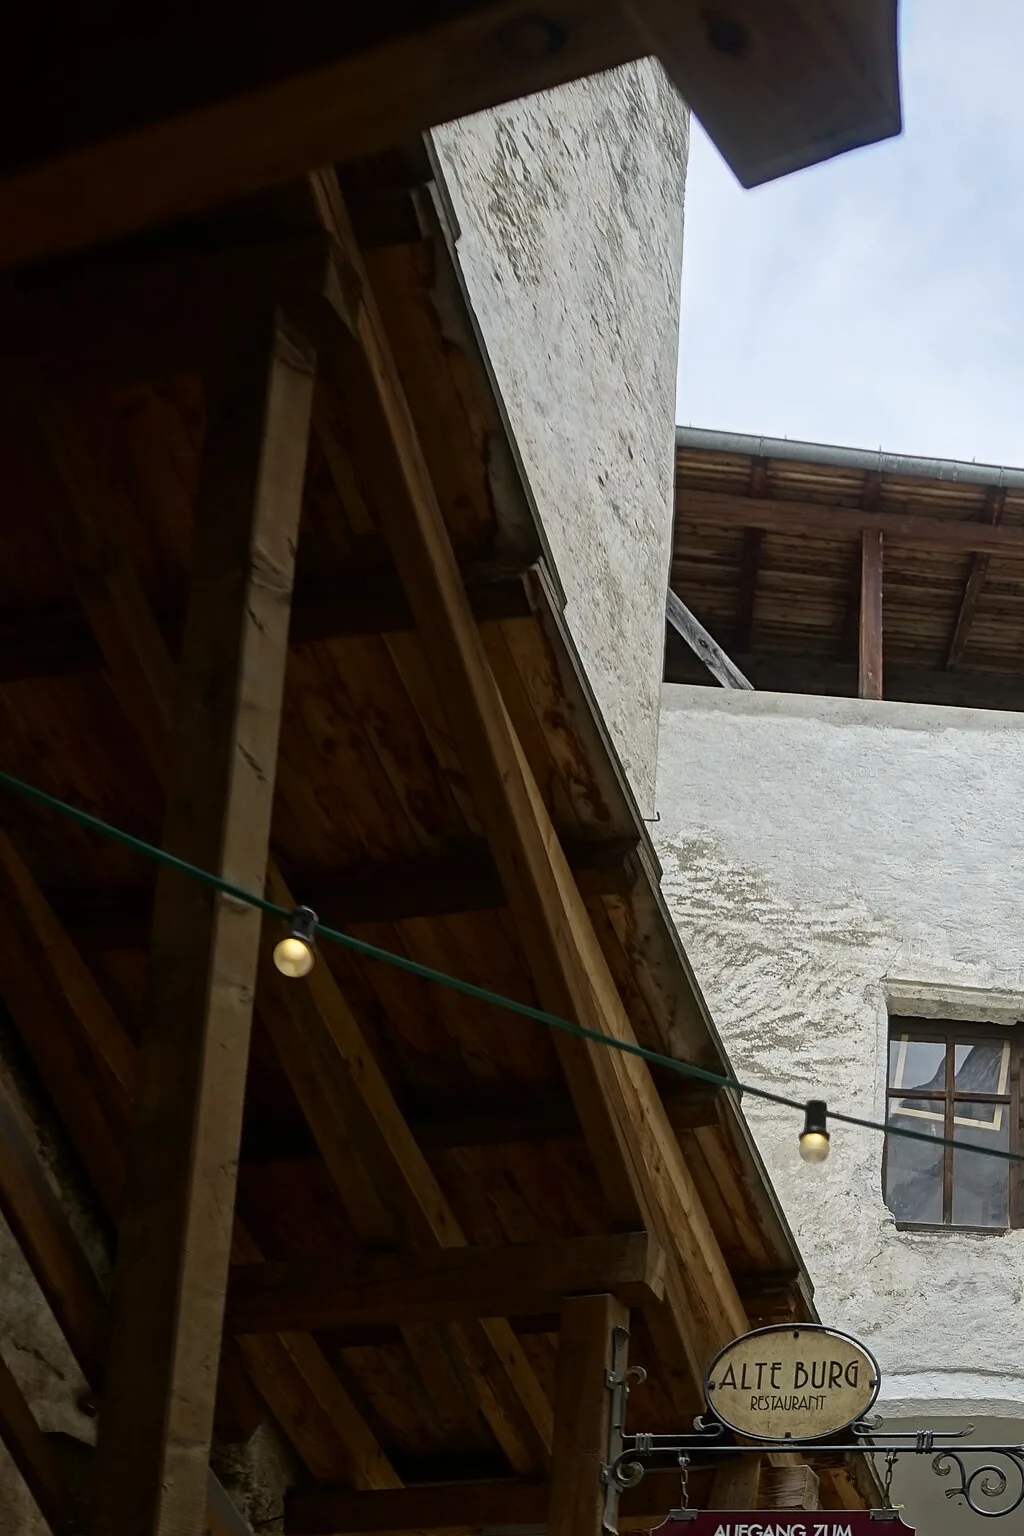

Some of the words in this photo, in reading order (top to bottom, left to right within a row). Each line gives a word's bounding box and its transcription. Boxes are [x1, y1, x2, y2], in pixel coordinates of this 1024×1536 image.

[719, 1362, 782, 1390] ALTE
[794, 1360, 859, 1389] BURG
[750, 1395, 826, 1411] RESTAURANT
